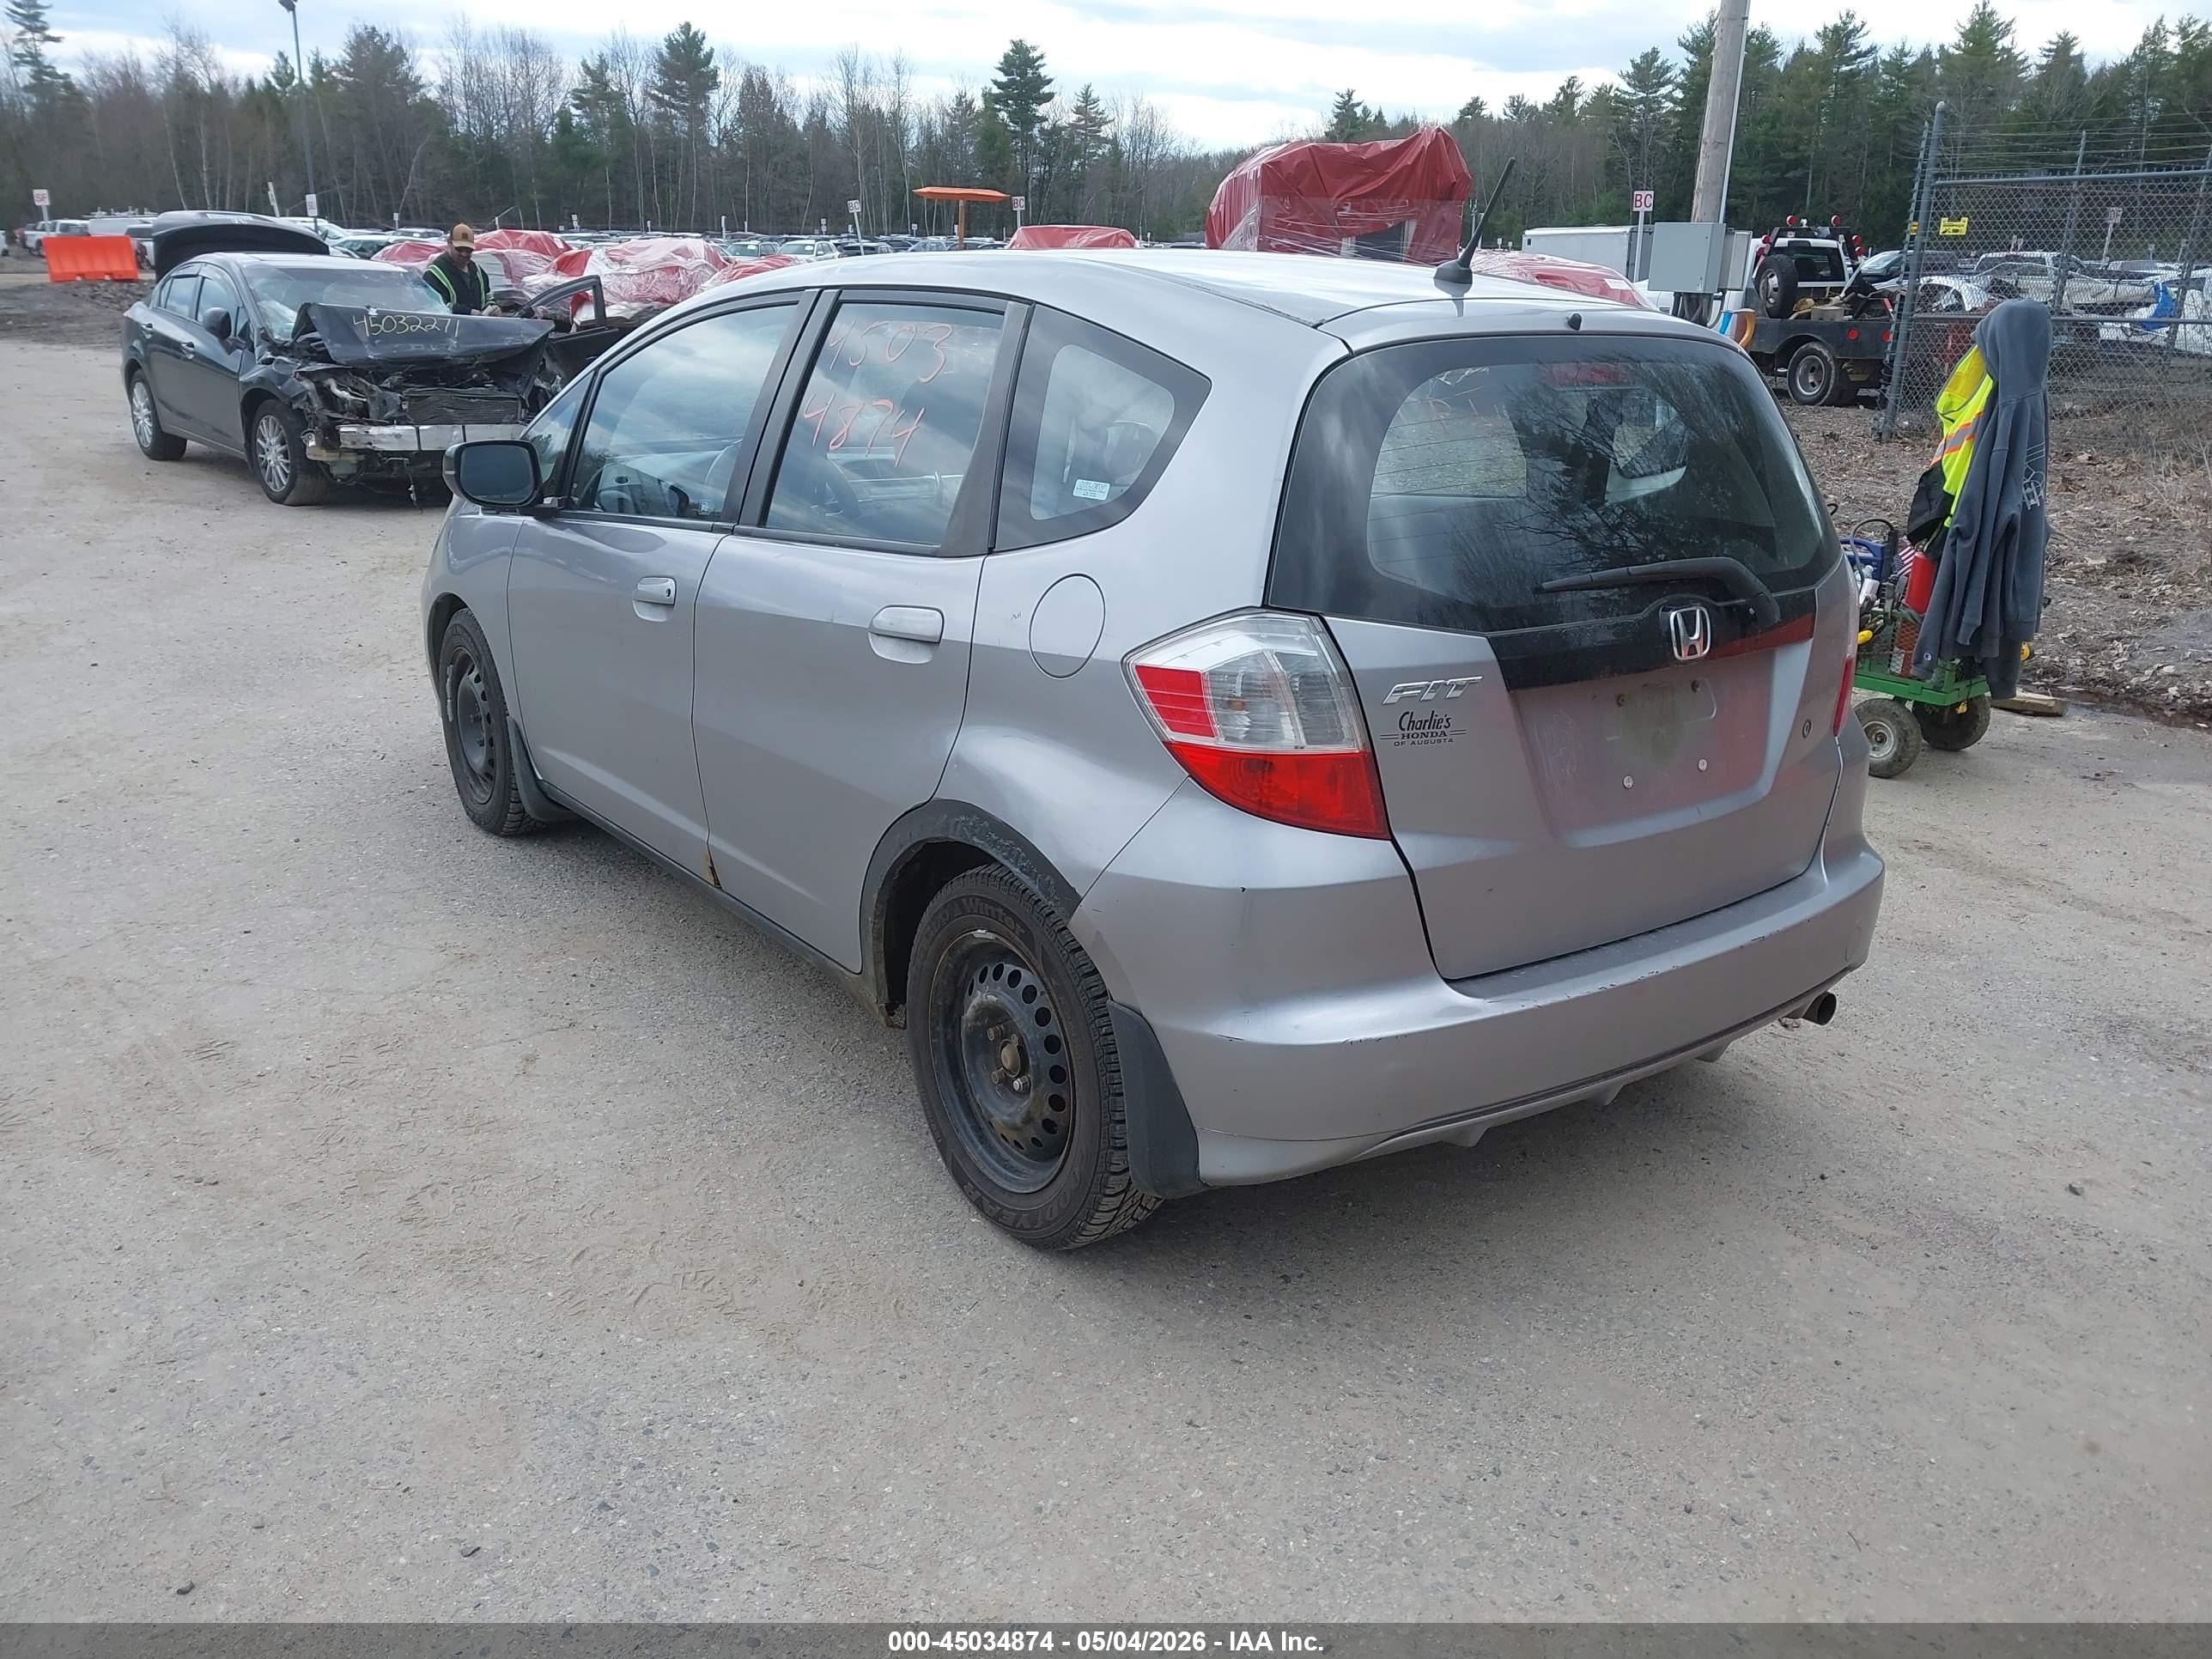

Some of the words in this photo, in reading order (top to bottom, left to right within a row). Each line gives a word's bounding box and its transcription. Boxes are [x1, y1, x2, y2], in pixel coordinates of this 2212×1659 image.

[848, 201, 860, 211] BC
[1013, 198, 1024, 209] BC
[1634, 193, 1653, 209] BC
[353, 314, 460, 337] 45032271
[828, 319, 954, 384] 4503
[803, 392, 927, 468] 4874
[1382, 676, 1484, 705] FIT
[1398, 710, 1452, 732] Charlie's
[1401, 730, 1448, 740] HONDA
[1409, 738, 1454, 746] AUGUSTA
